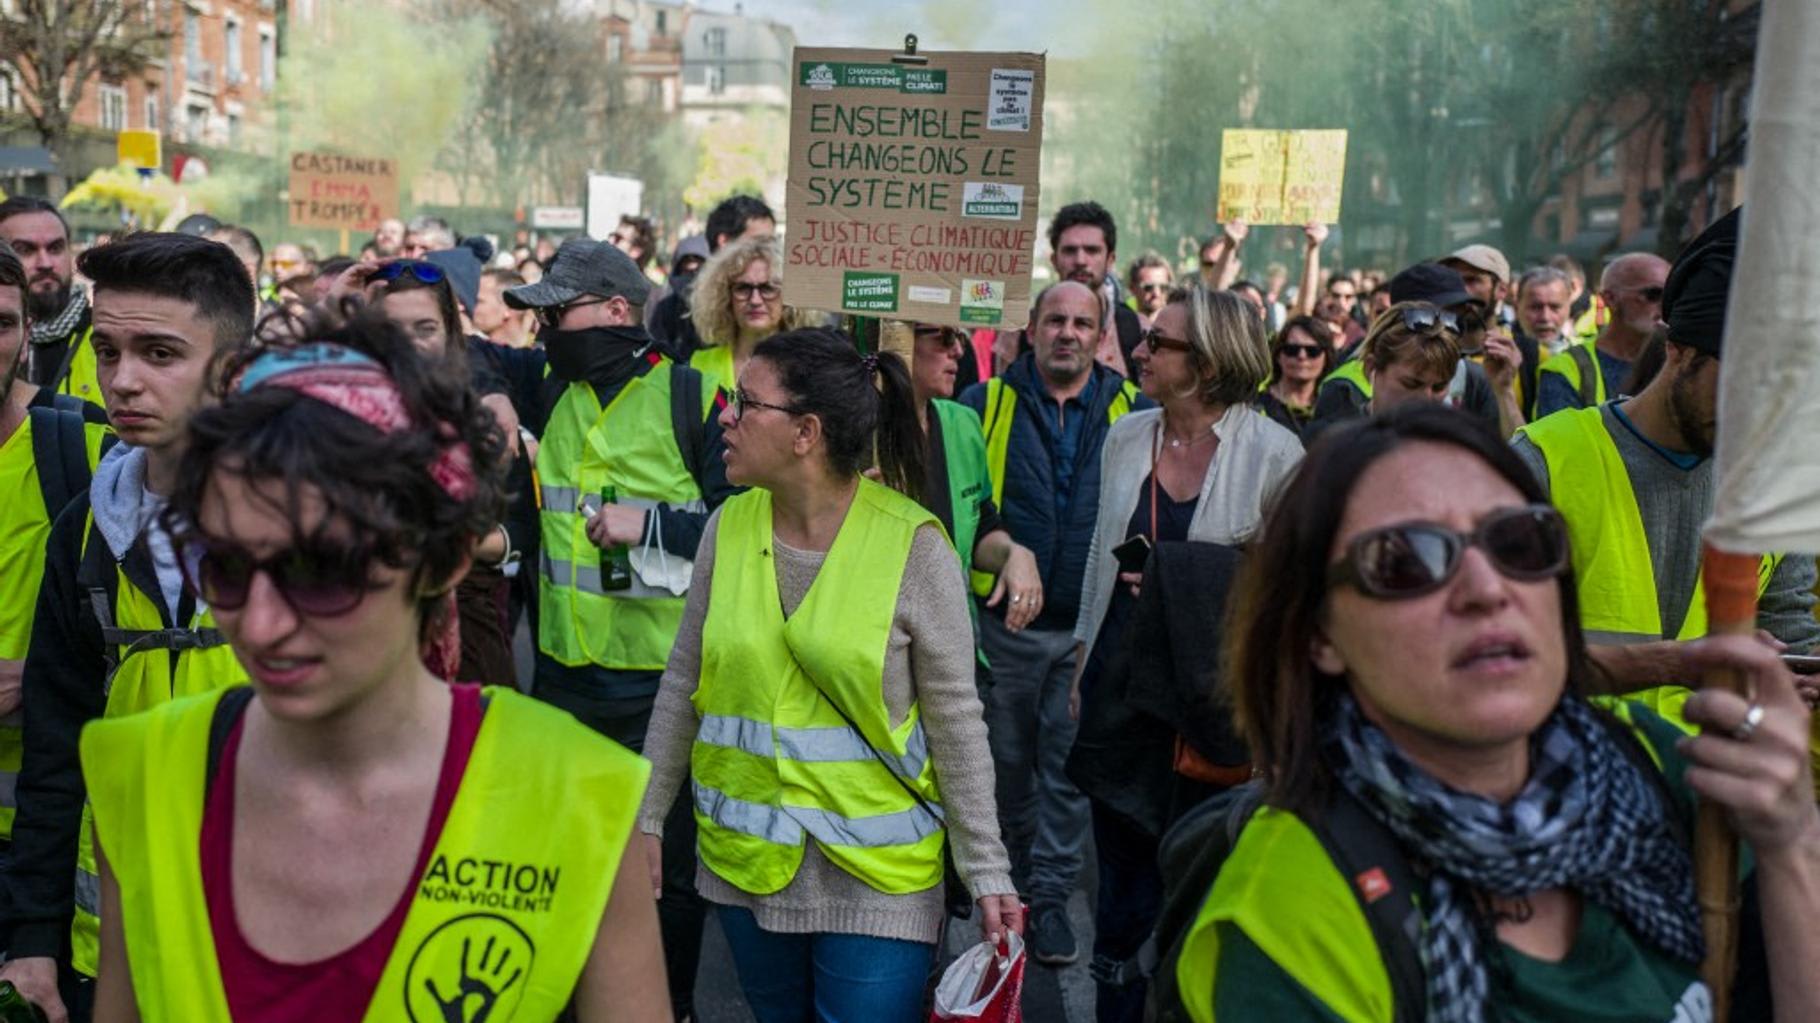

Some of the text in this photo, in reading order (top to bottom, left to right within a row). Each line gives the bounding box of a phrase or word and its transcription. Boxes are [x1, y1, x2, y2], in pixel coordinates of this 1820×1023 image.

[810, 104, 984, 140] ENSEMBLE
[808, 141, 1016, 176] CHANGEONS LE
[807, 175, 950, 211] SYSTÈME
[801, 219, 1034, 251] JUSTICE CLIMATIQUE
[789, 243, 872, 268] SOCIALE
[890, 247, 1029, 276] ÉCONOMIQUE
[425, 854, 560, 894] ACTION
